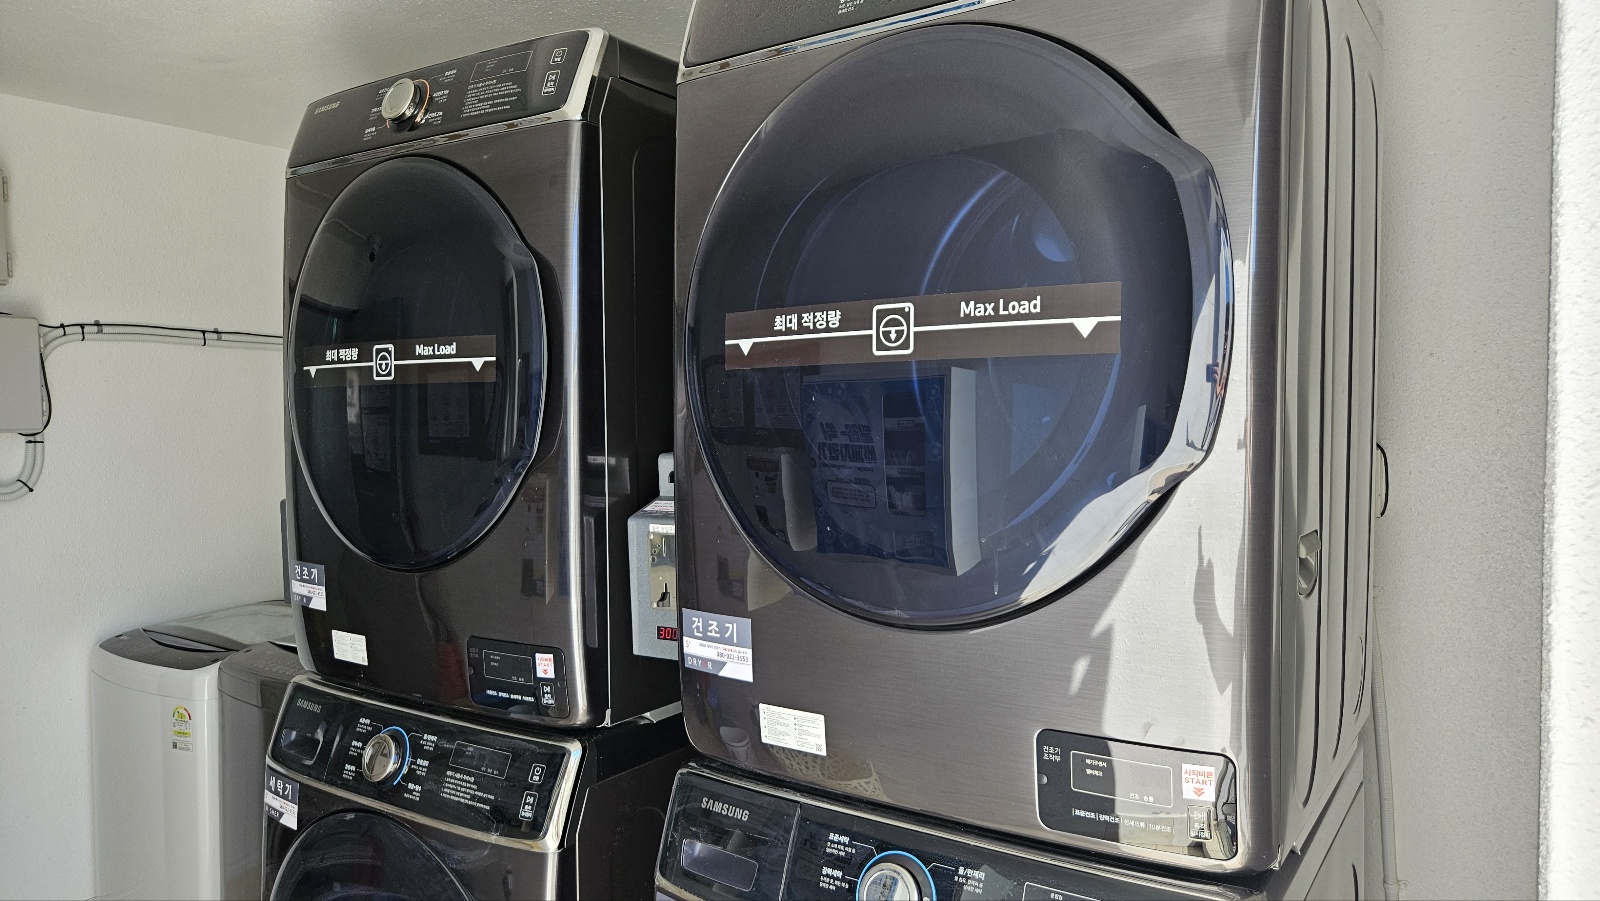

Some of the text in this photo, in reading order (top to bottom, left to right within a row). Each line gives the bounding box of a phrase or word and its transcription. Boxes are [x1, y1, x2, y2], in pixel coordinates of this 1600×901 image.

[314, 101, 341, 115] SAMSUNG
[959, 295, 1042, 318] Max Load
[773, 309, 842, 332] 최대 적정량
[325, 347, 359, 362] 최대 적정량
[415, 341, 457, 356] Max Load
[294, 564, 318, 584] 건조기
[659, 627, 679, 640] 300
[691, 616, 737, 644] 건조기
[296, 698, 322, 714] SAMSUNG
[1042, 745, 1061, 756] 건조기
[269, 775, 292, 800] 세탁기
[1184, 776, 1214, 787] START
[701, 797, 750, 822] SAMSUNG
